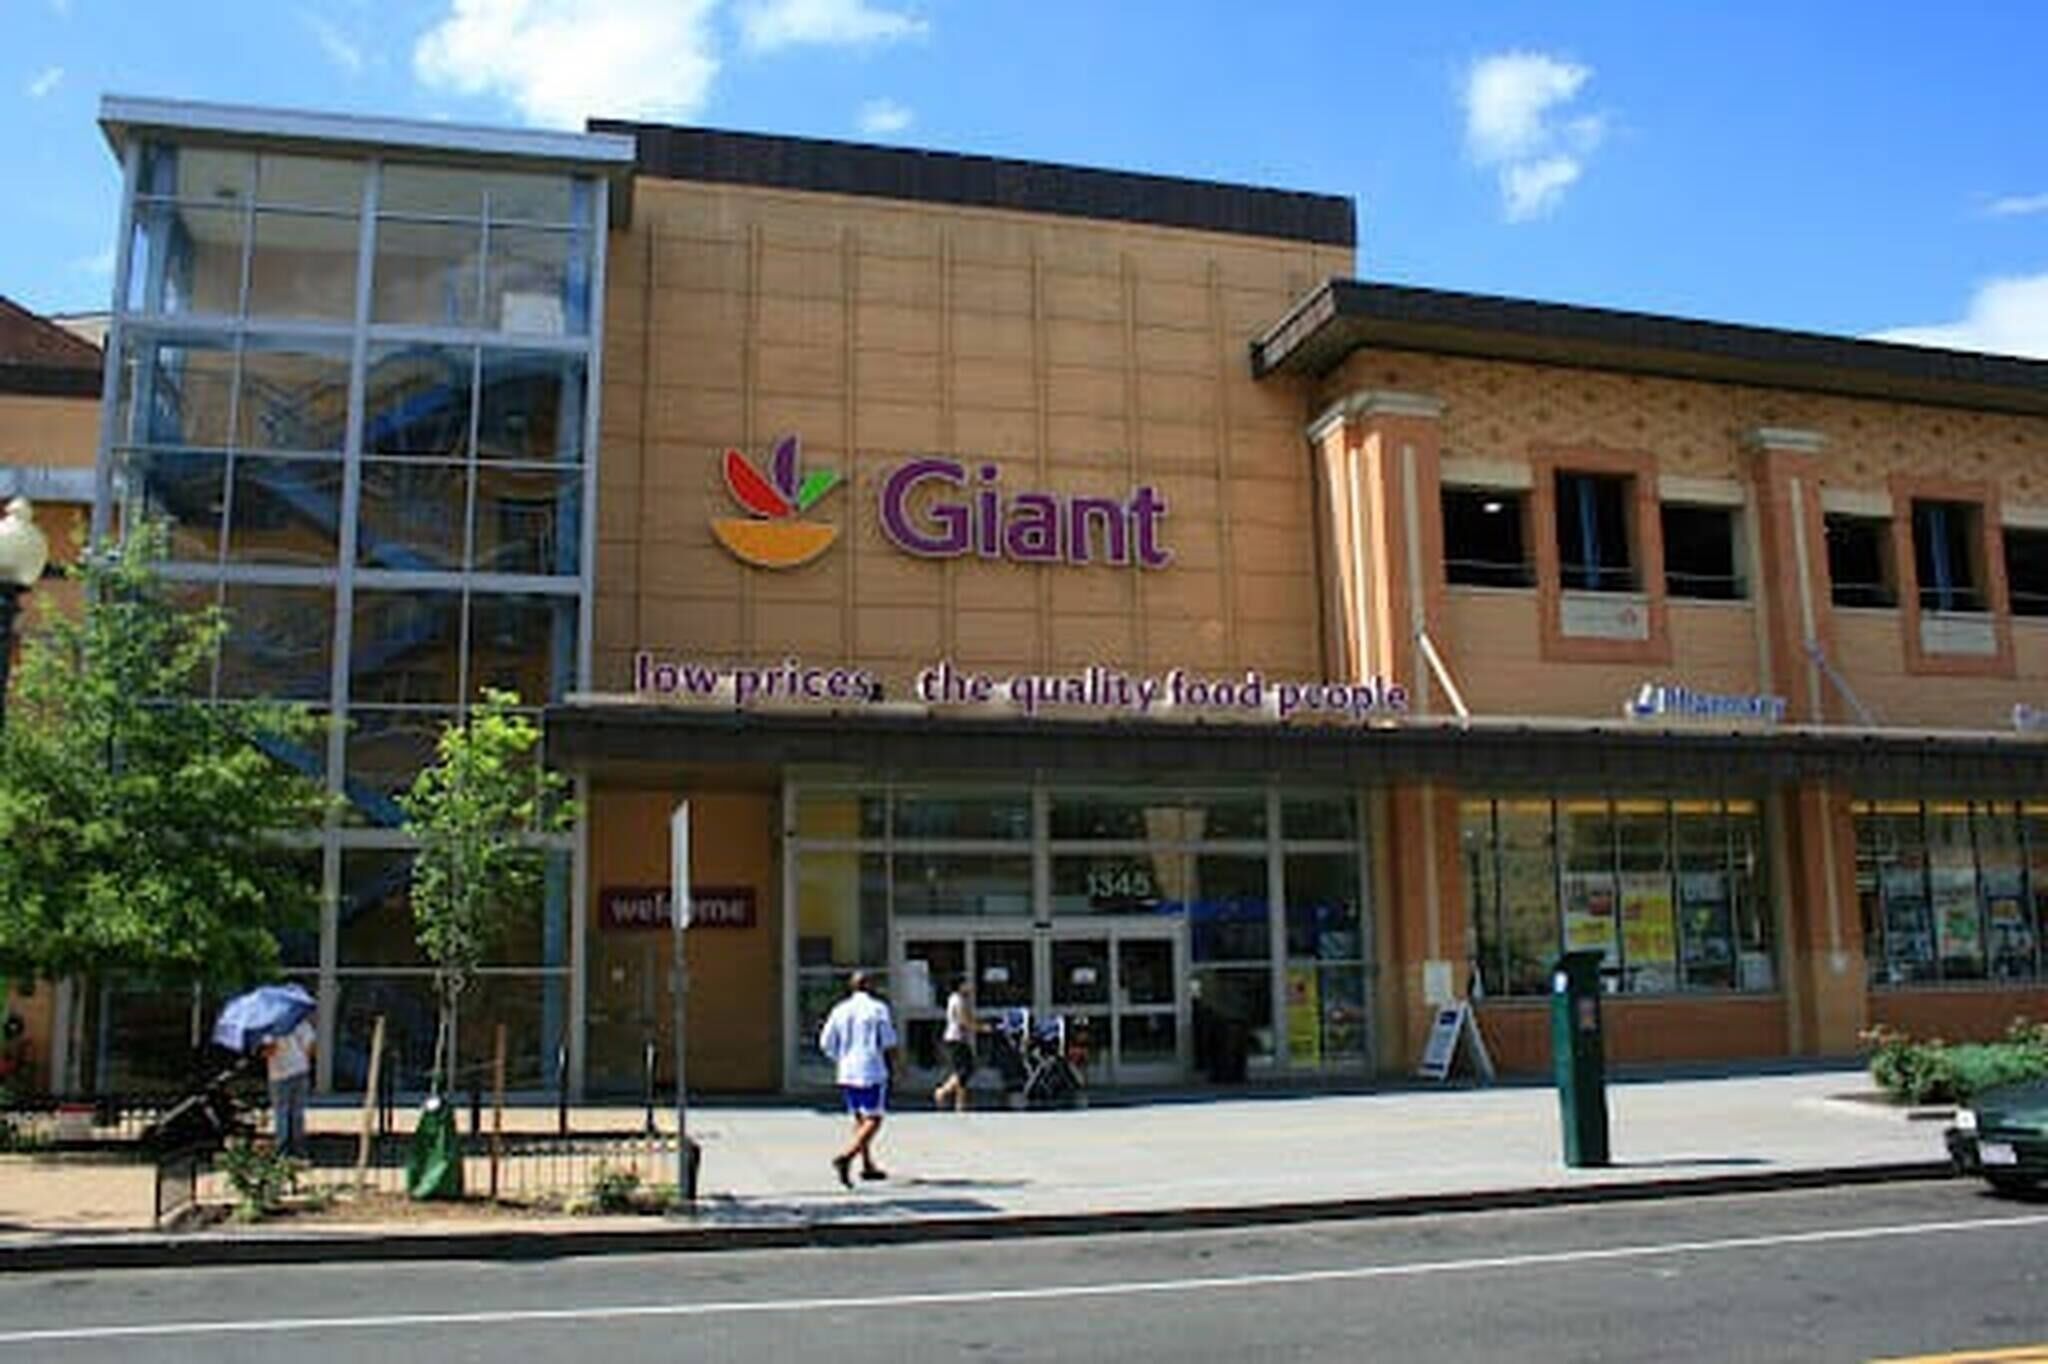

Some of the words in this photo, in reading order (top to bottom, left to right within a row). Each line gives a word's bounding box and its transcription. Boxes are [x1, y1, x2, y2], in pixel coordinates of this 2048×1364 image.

[879, 458, 1176, 569] Giant
[636, 652, 717, 696] low
[917, 660, 994, 703] the
[1007, 664, 1158, 714] quality
[1167, 667, 1263, 708] food
[1274, 675, 1408, 719] people
